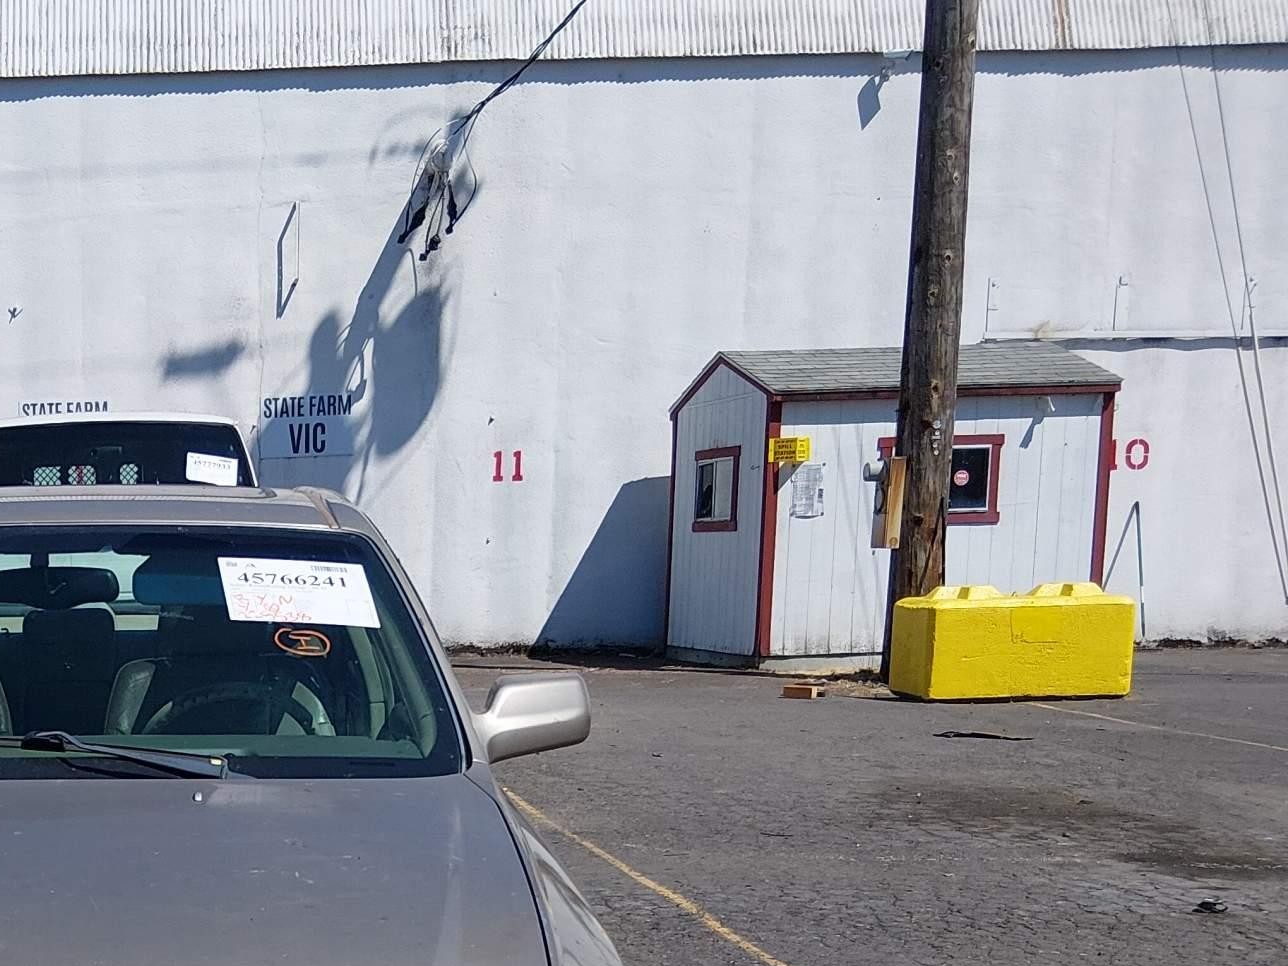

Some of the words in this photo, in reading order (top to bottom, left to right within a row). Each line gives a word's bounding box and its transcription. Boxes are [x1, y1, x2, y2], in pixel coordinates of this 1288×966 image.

[263, 396, 305, 419] STATE
[309, 393, 352, 416] FARM
[288, 422, 326, 455] VIC
[493, 450, 523, 482] 11
[237, 571, 347, 588] 45766241
